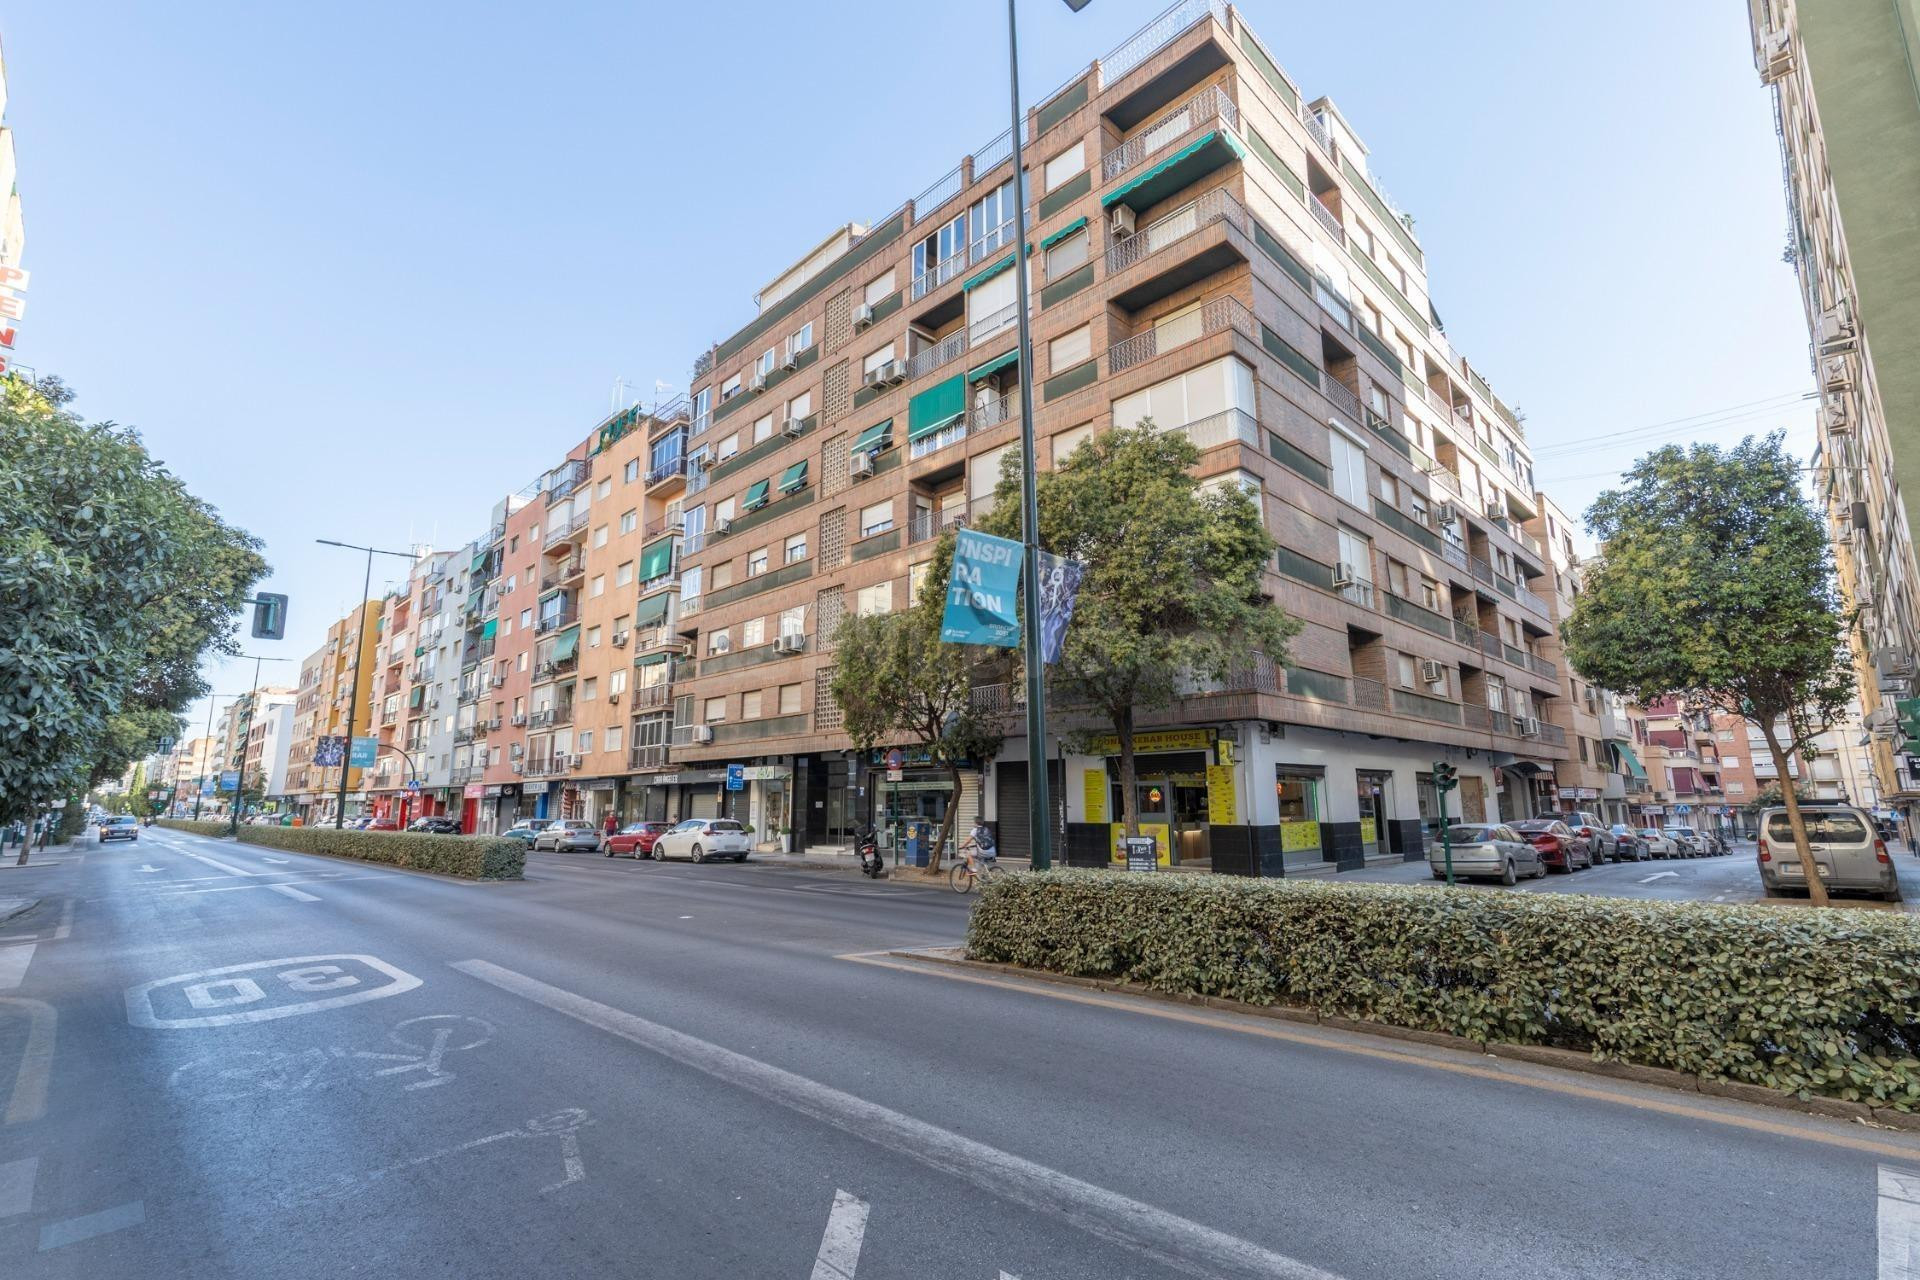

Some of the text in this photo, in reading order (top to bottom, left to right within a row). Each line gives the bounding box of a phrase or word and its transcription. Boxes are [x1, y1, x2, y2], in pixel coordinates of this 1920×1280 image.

[959, 538, 1012, 567] INSPI
[955, 563, 982, 586] RA
[952, 587, 1003, 613] TION
[1165, 732, 1201, 742] HOUSE
